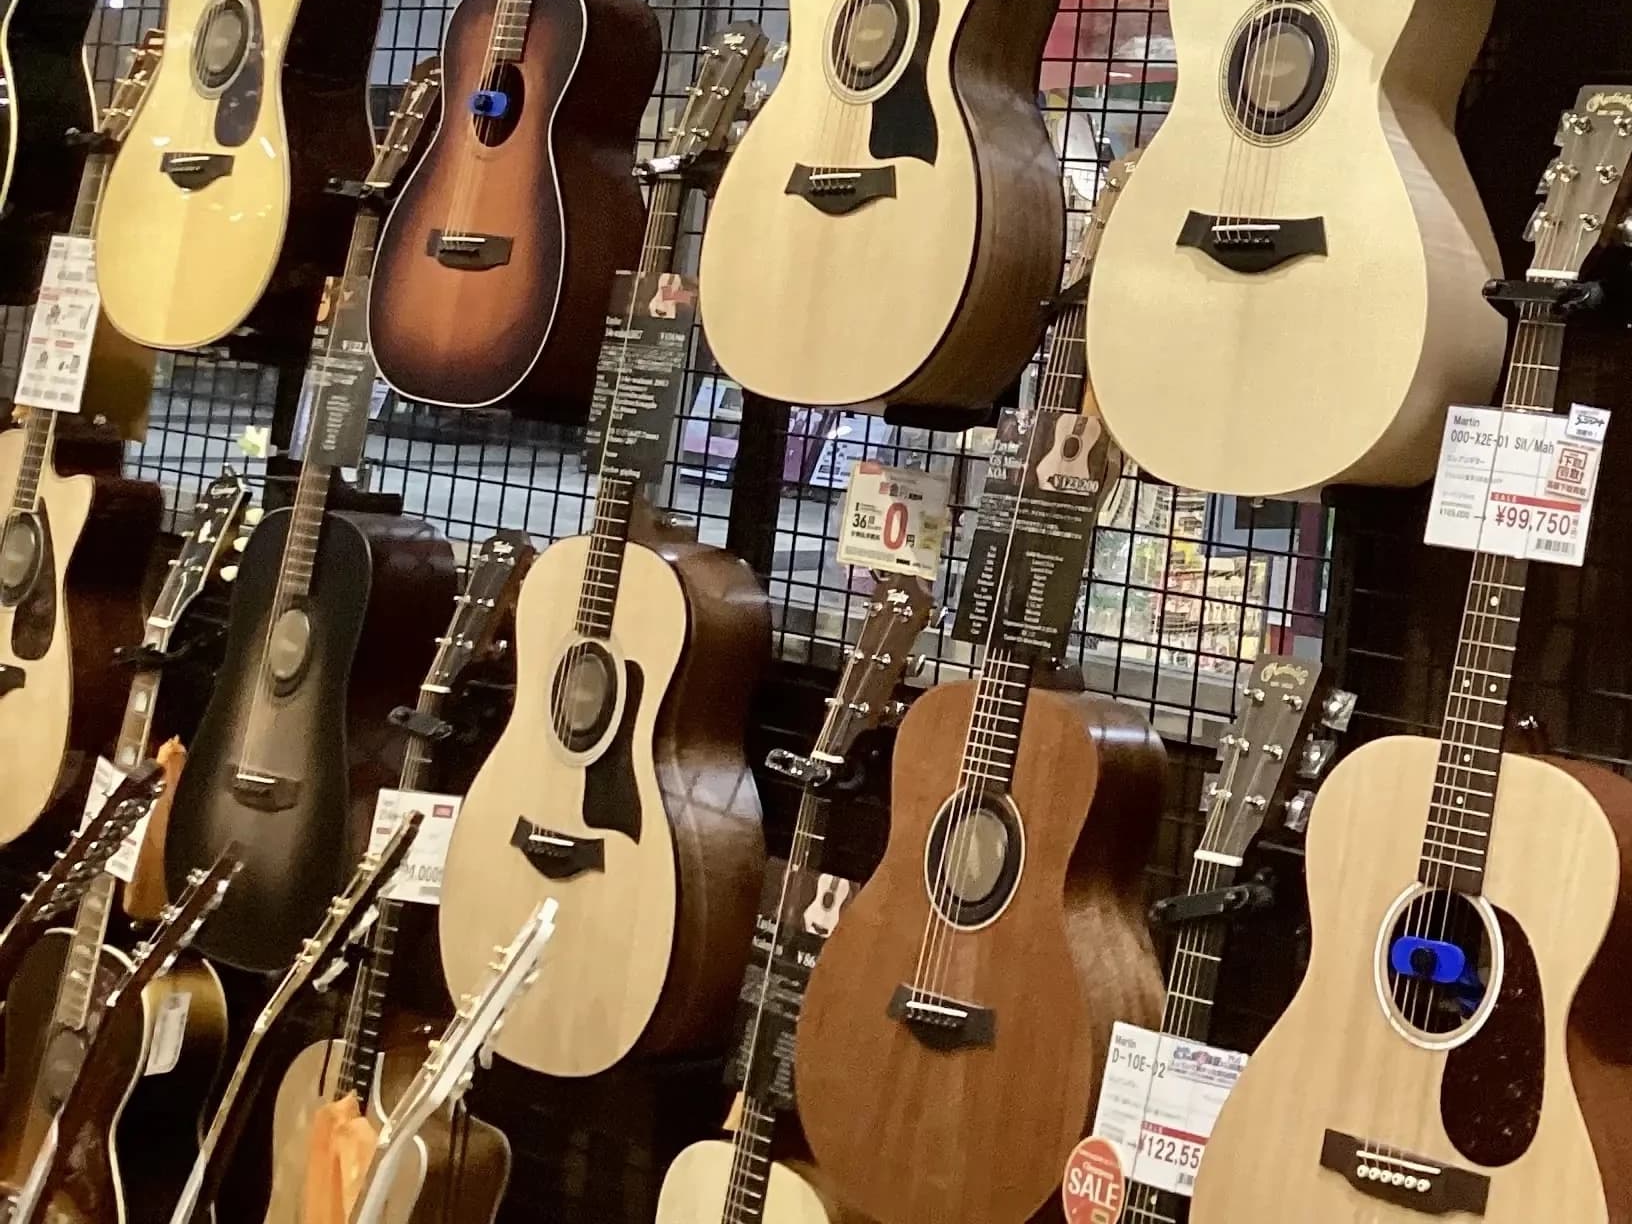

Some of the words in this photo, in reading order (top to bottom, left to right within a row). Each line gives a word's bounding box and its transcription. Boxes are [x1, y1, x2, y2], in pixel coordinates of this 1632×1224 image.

[1453, 414, 1481, 428] Martin
[852, 514, 867, 528] 36
[1495, 504, 1571, 536] ¥99,750
[1068, 1166, 1121, 1212] SALE
